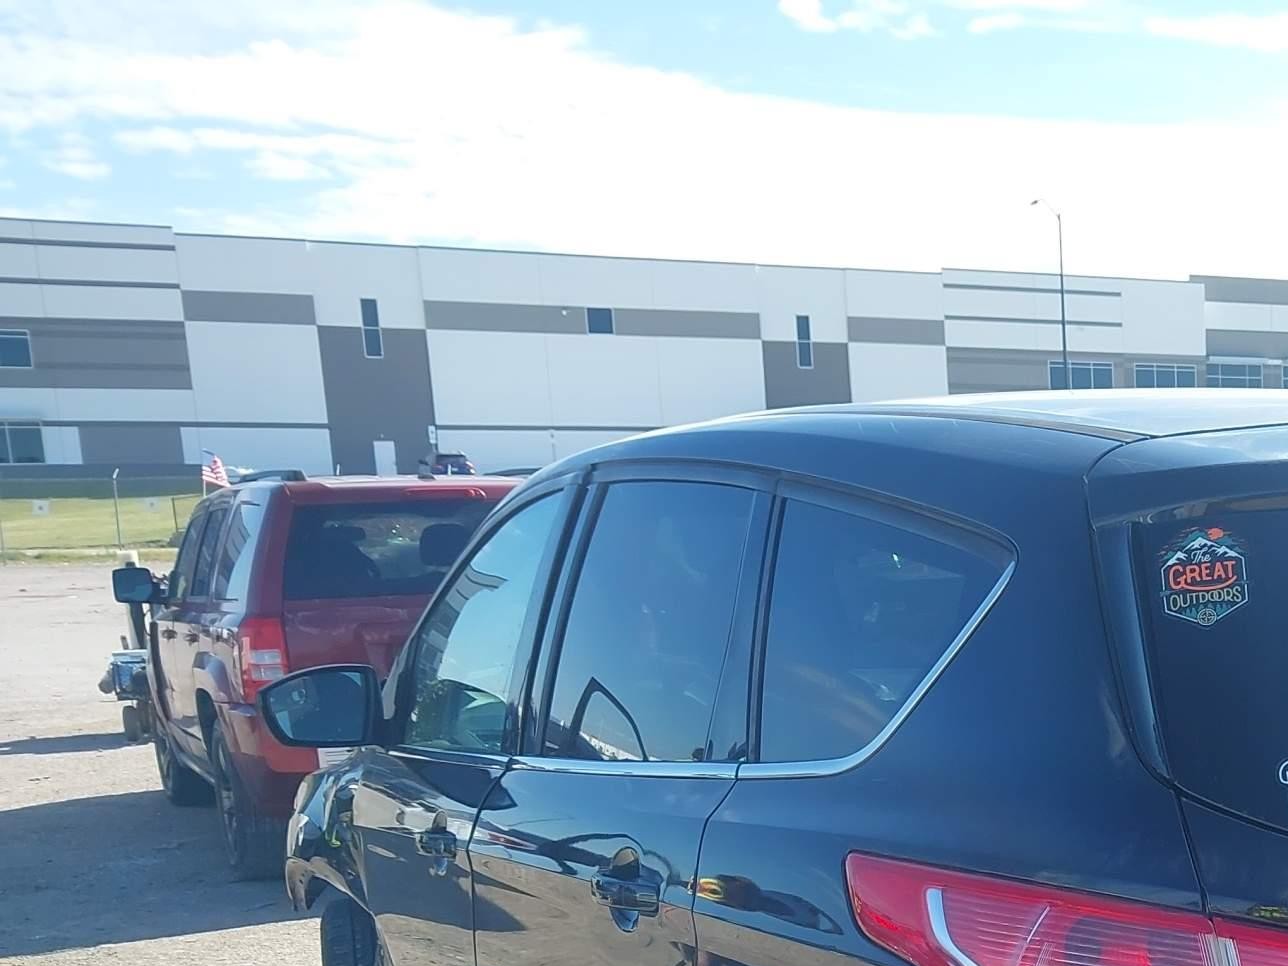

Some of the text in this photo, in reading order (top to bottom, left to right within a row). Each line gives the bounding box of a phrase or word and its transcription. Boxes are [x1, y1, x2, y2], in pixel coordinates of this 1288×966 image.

[1191, 547, 1211, 564] The
[1169, 560, 1237, 590] GREAT
[1170, 586, 1242, 611] OUTDOORS
